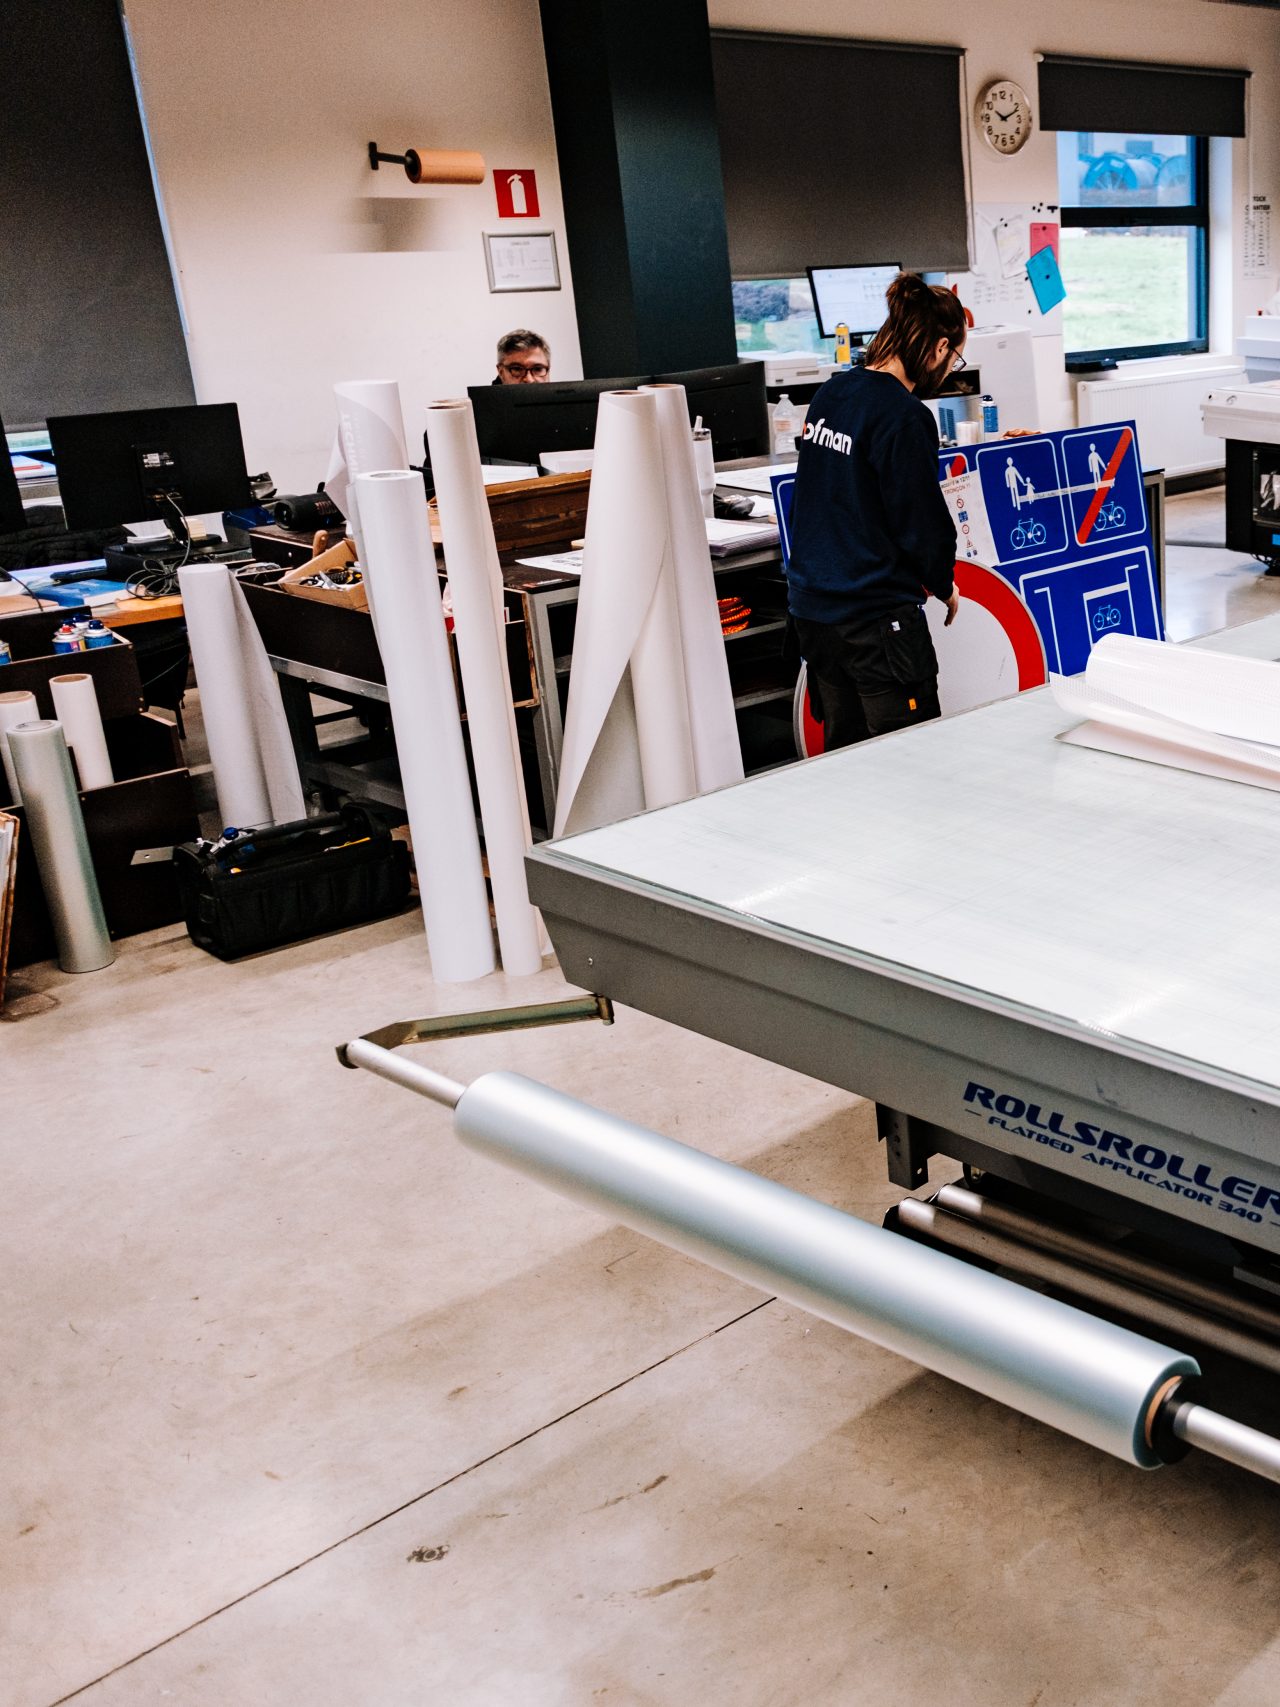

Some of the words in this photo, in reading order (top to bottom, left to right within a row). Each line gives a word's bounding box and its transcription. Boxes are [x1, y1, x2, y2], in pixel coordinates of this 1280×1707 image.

[803, 418, 852, 456] ofman
[988, 1116, 1075, 1154] FLATBED
[1080, 1152, 1213, 1207] APPLICATOR
[1218, 1200, 1262, 1224] 340
